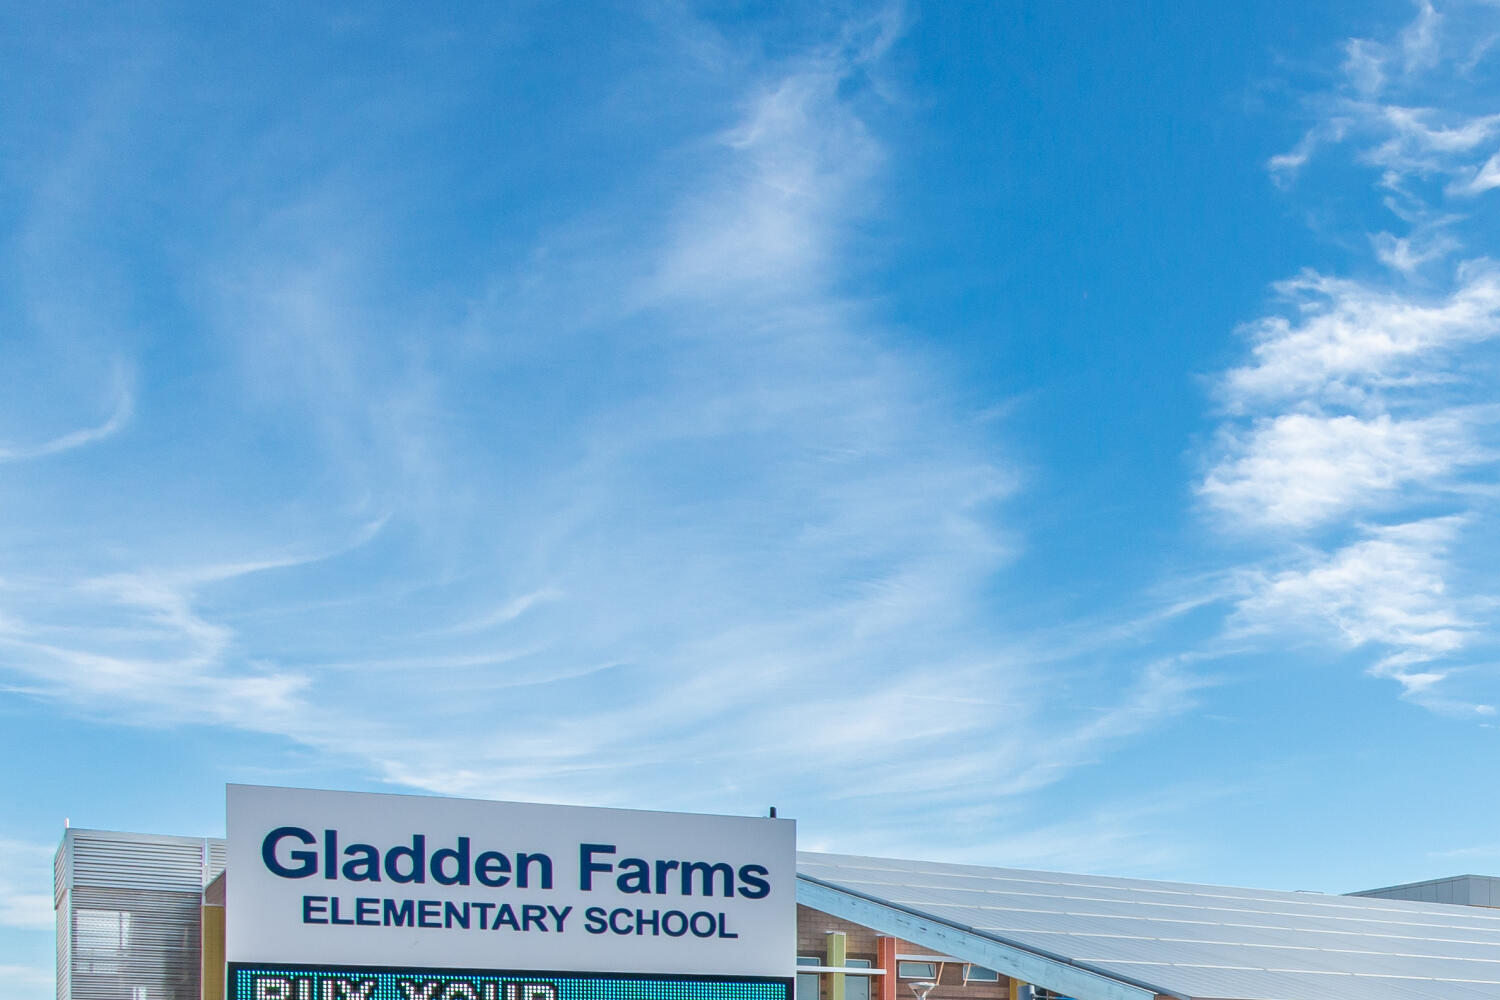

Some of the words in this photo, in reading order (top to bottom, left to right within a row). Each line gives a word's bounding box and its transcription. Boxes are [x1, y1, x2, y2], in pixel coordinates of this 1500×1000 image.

[261, 826, 553, 889] Gladden
[579, 843, 771, 900] Farms
[302, 896, 573, 933] ELEMENTARY
[584, 906, 739, 939] SCHOOL
